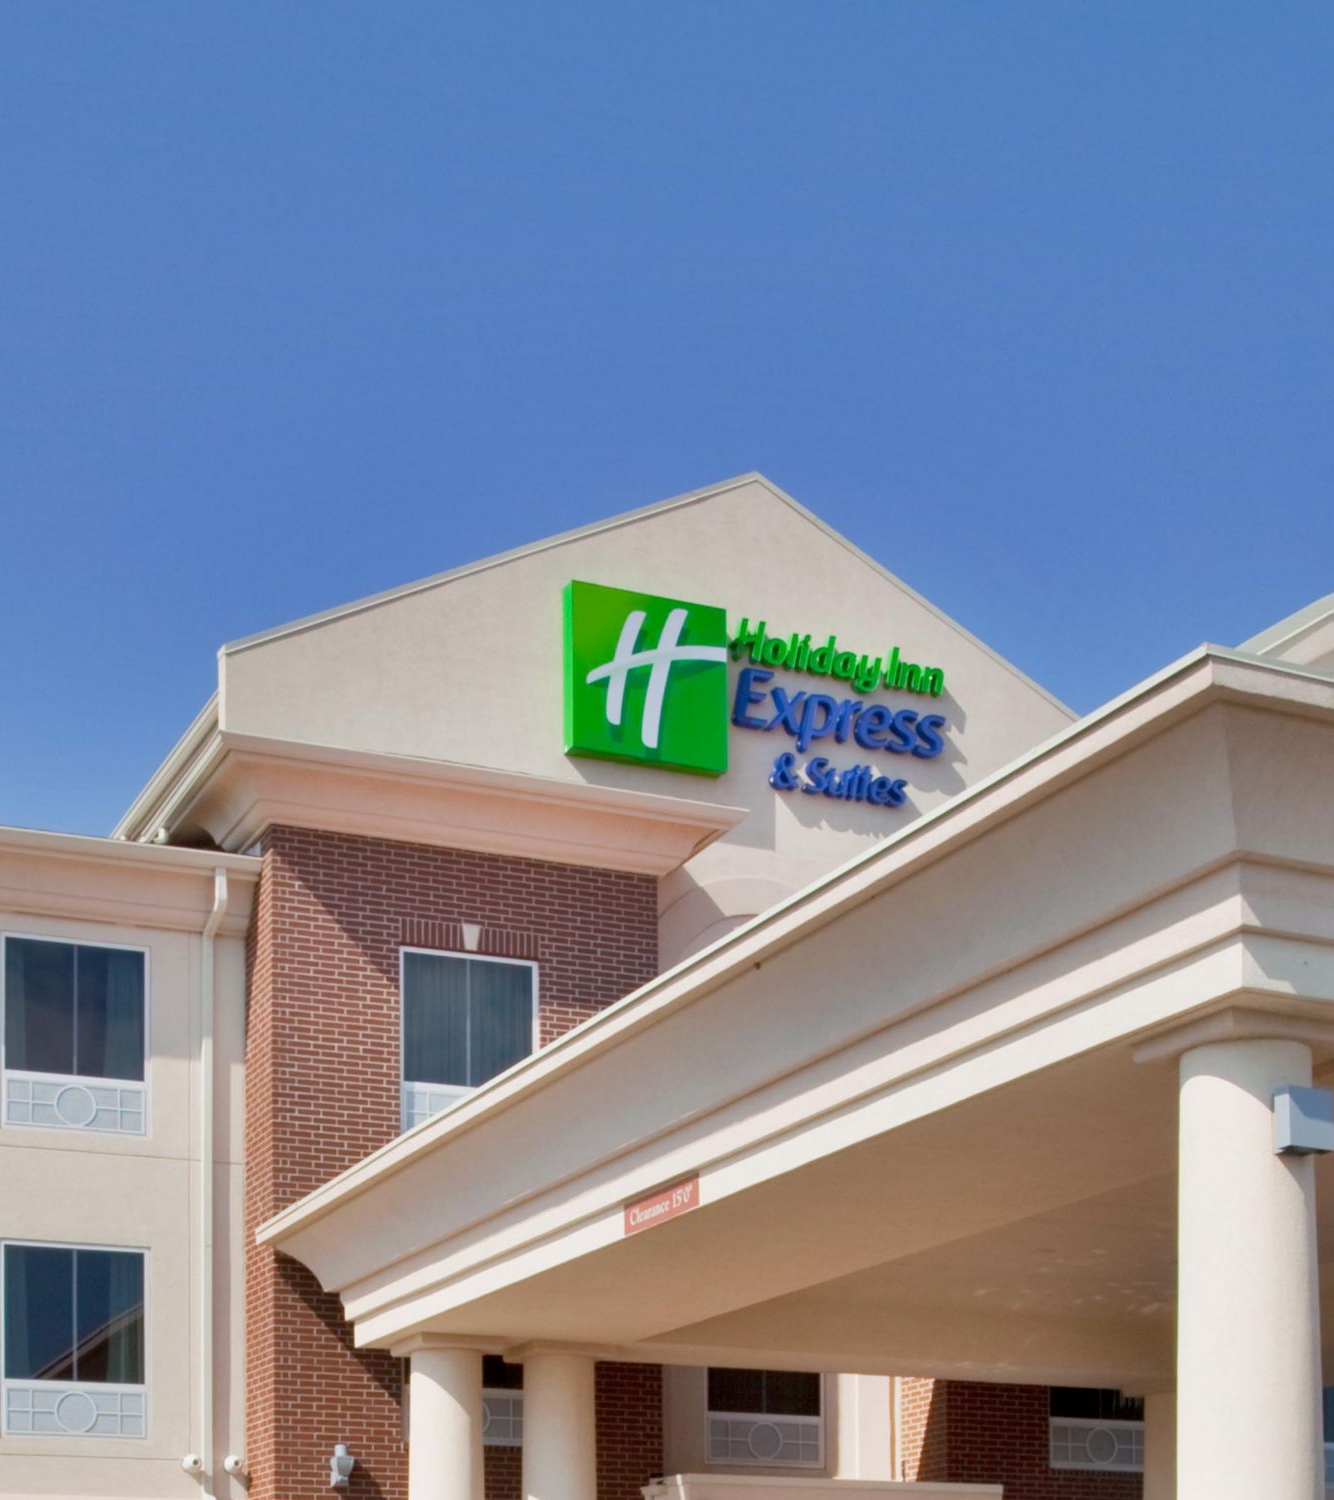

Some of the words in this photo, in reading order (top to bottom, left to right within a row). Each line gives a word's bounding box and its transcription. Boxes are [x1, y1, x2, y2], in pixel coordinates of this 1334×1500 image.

[728, 618, 882, 693] Holiday
[884, 647, 945, 697] Inn
[731, 667, 947, 759] Express
[769, 752, 798, 790] &
[802, 757, 908, 808] Suites
[629, 1200, 670, 1226] Clearance
